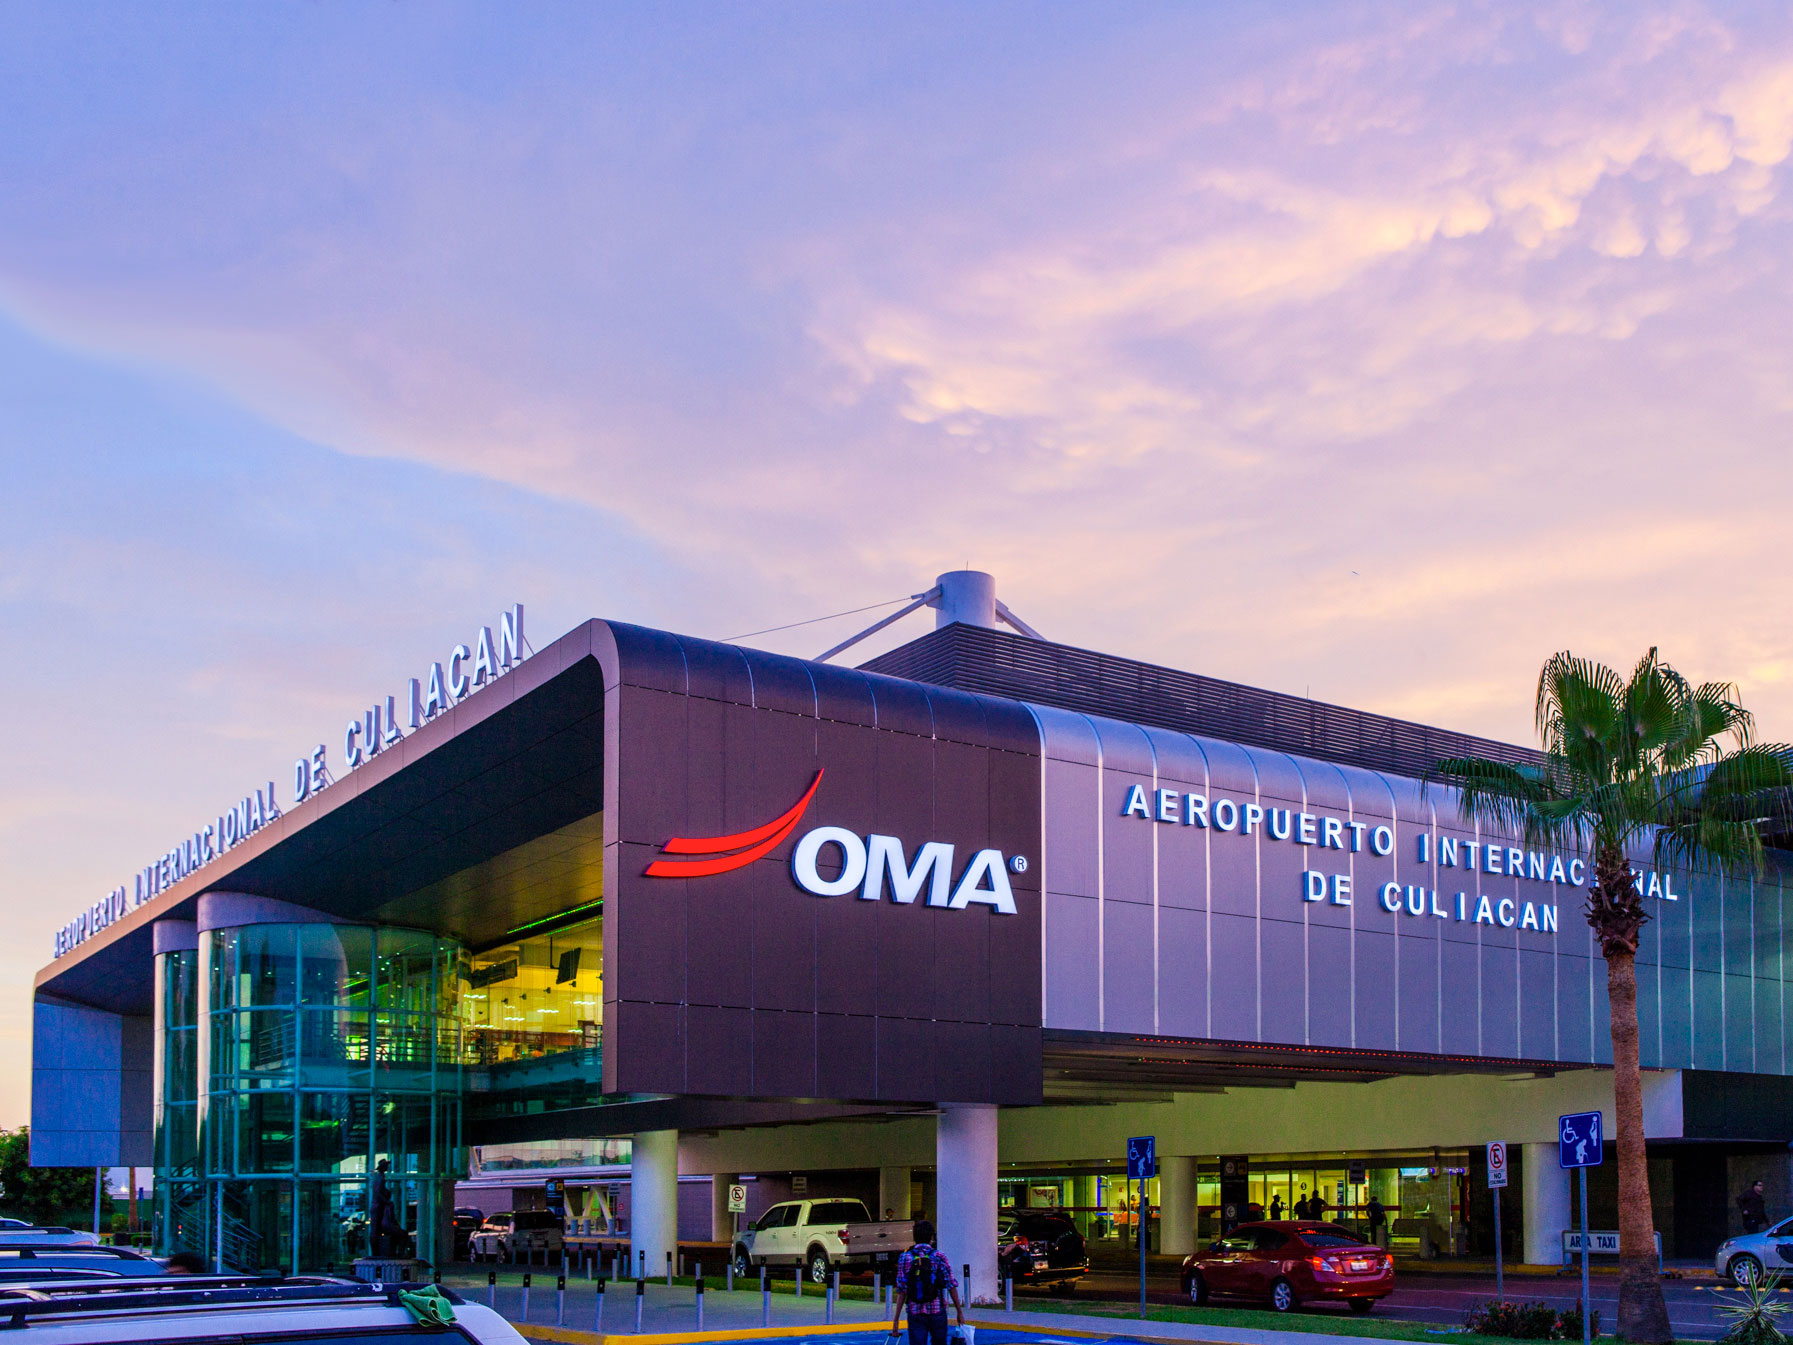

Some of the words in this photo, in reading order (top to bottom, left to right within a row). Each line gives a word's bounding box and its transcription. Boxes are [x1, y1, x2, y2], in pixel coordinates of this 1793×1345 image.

[54, 885, 126, 959] AEROPUERTO
[134, 781, 279, 905] INTERNACIONAL
[294, 744, 326, 802] DE
[344, 603, 524, 767] CULIACAN
[792, 825, 1018, 915] OMA
[1122, 783, 1395, 857] AEROPUERTO
[1419, 832, 1678, 901] INTERNACNAL
[1304, 870, 1352, 907] DE
[1380, 881, 1559, 933] CULIACAN
[1570, 1236, 1592, 1248] ARA
[1597, 1236, 1617, 1249] TAXI
